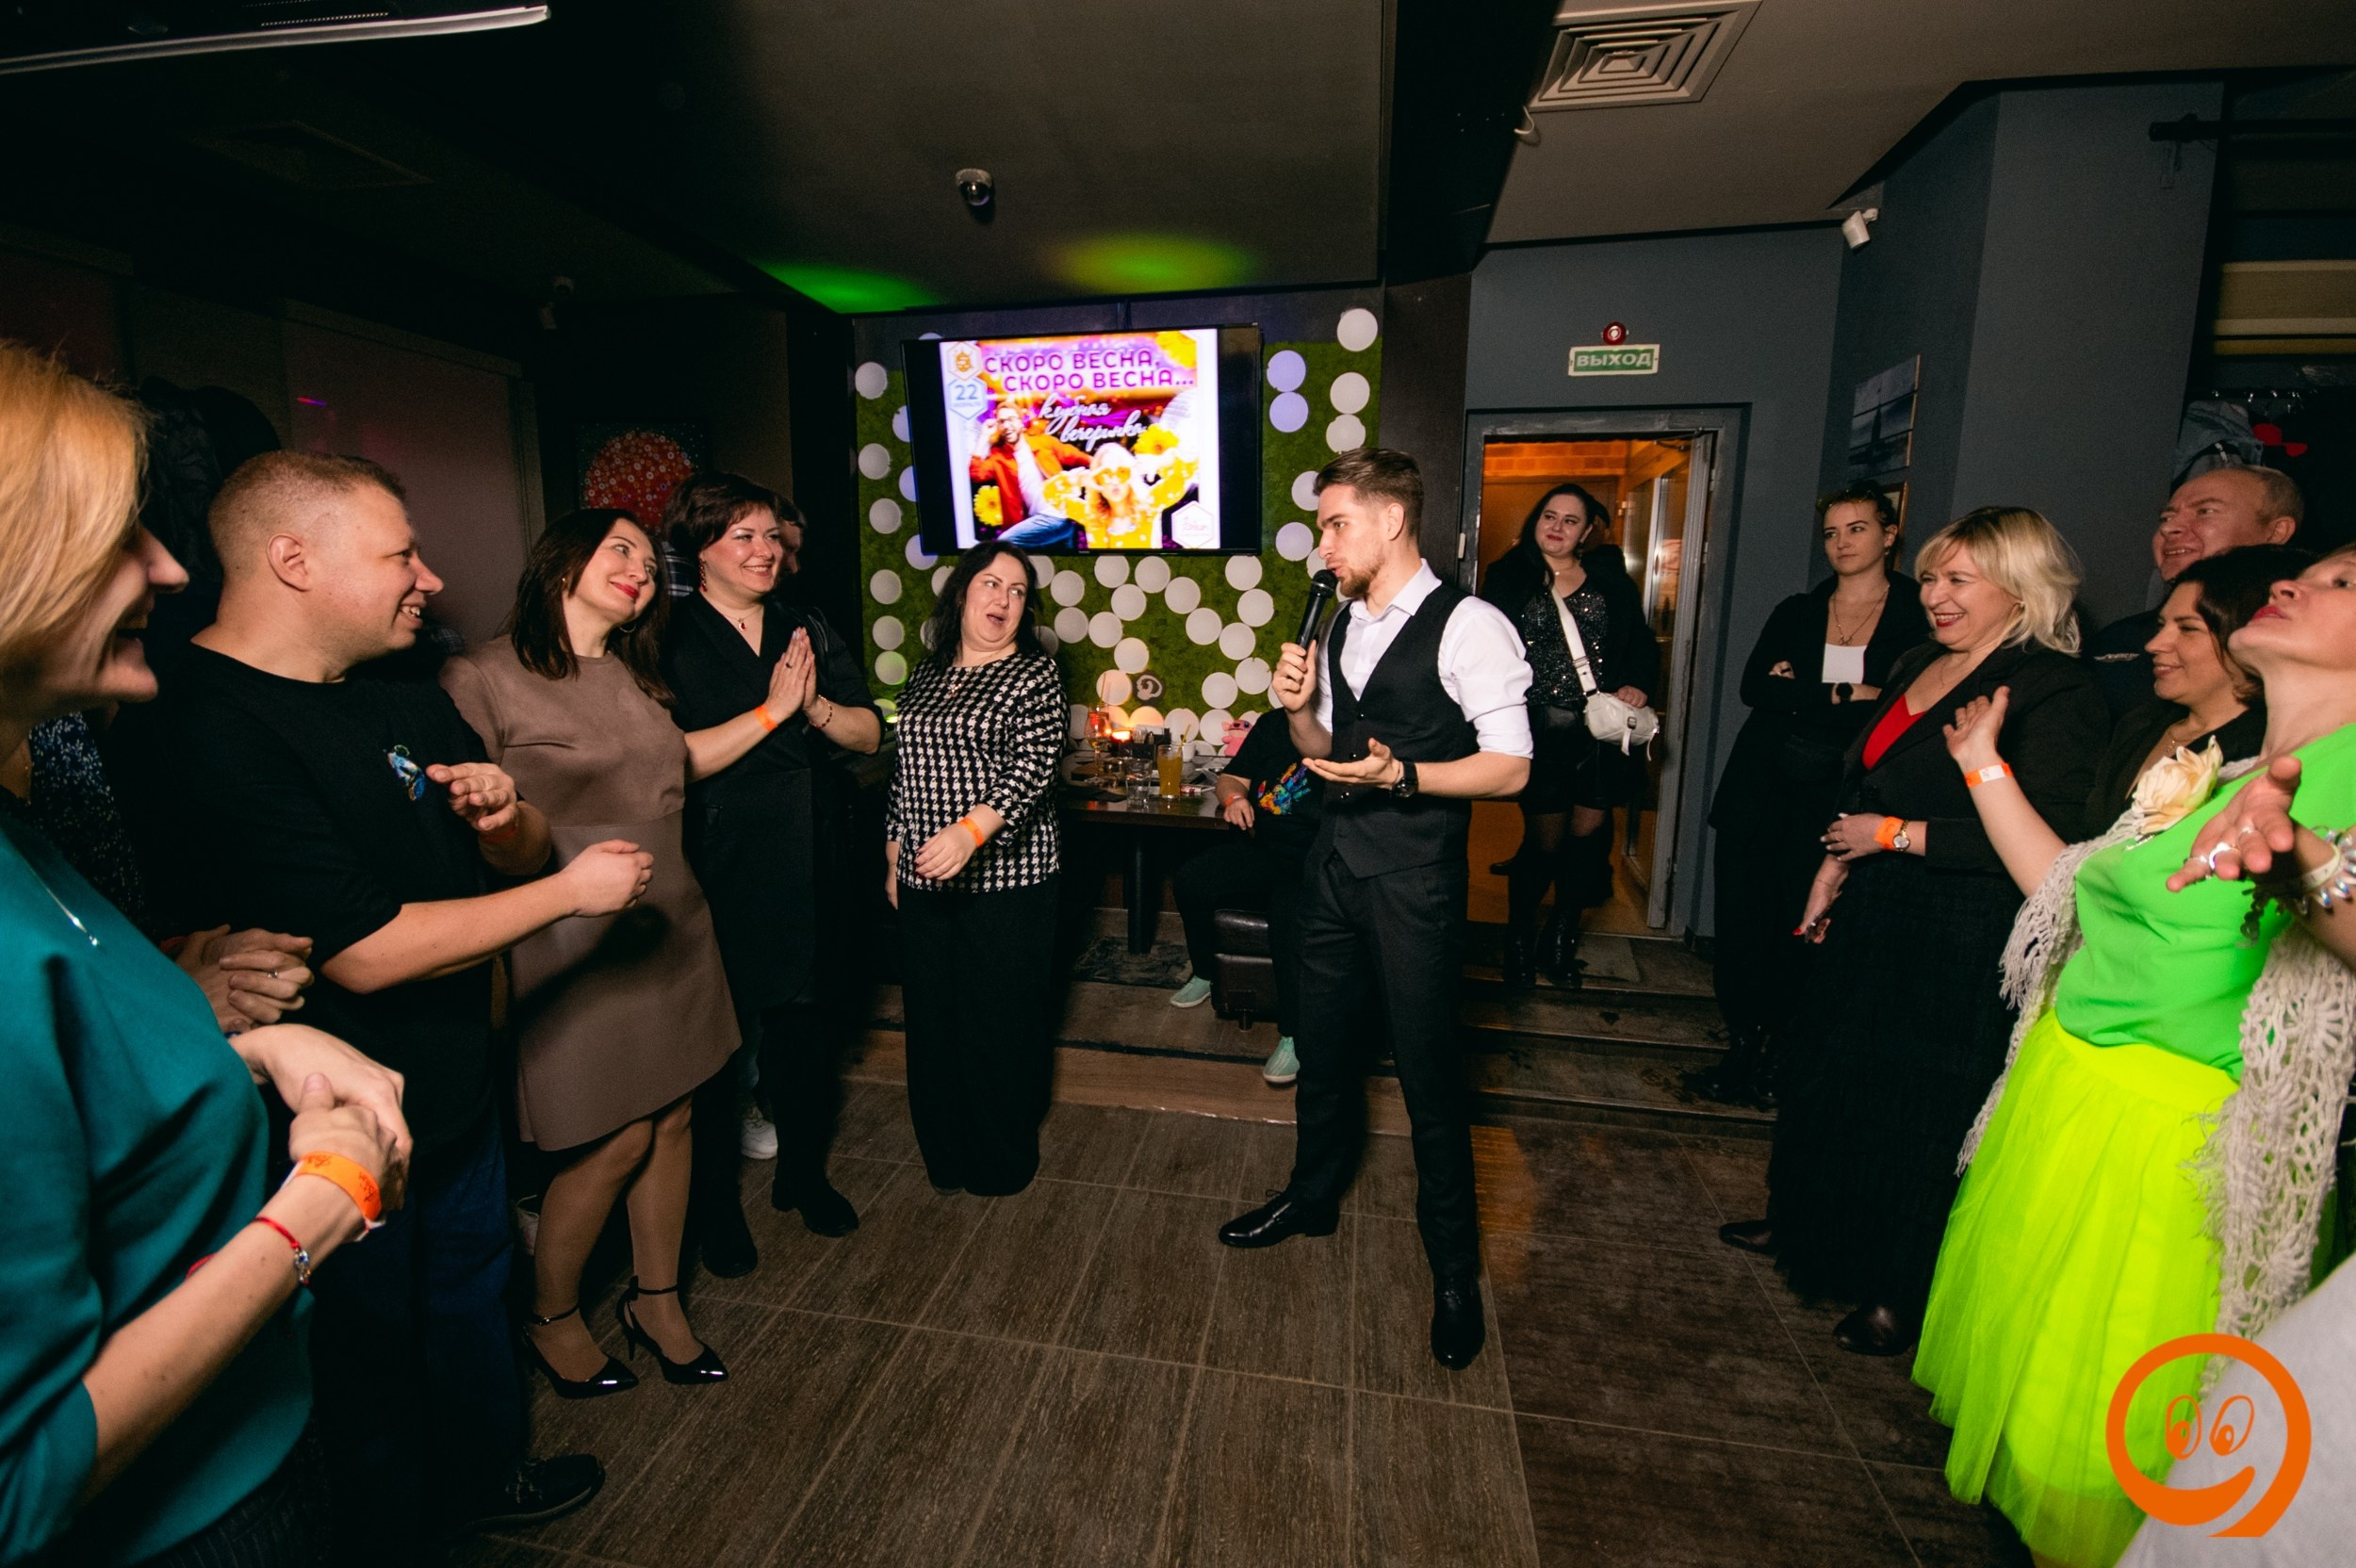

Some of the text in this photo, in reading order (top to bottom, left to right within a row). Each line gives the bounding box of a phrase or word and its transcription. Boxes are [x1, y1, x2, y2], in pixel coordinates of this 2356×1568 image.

[984, 349, 1160, 373] СКОРО ВЕСНА,
[1577, 352, 1652, 368] ВЫХОД
[1004, 368, 1194, 392] СКОРО ВЕСНА...
[954, 384, 978, 400] 22
